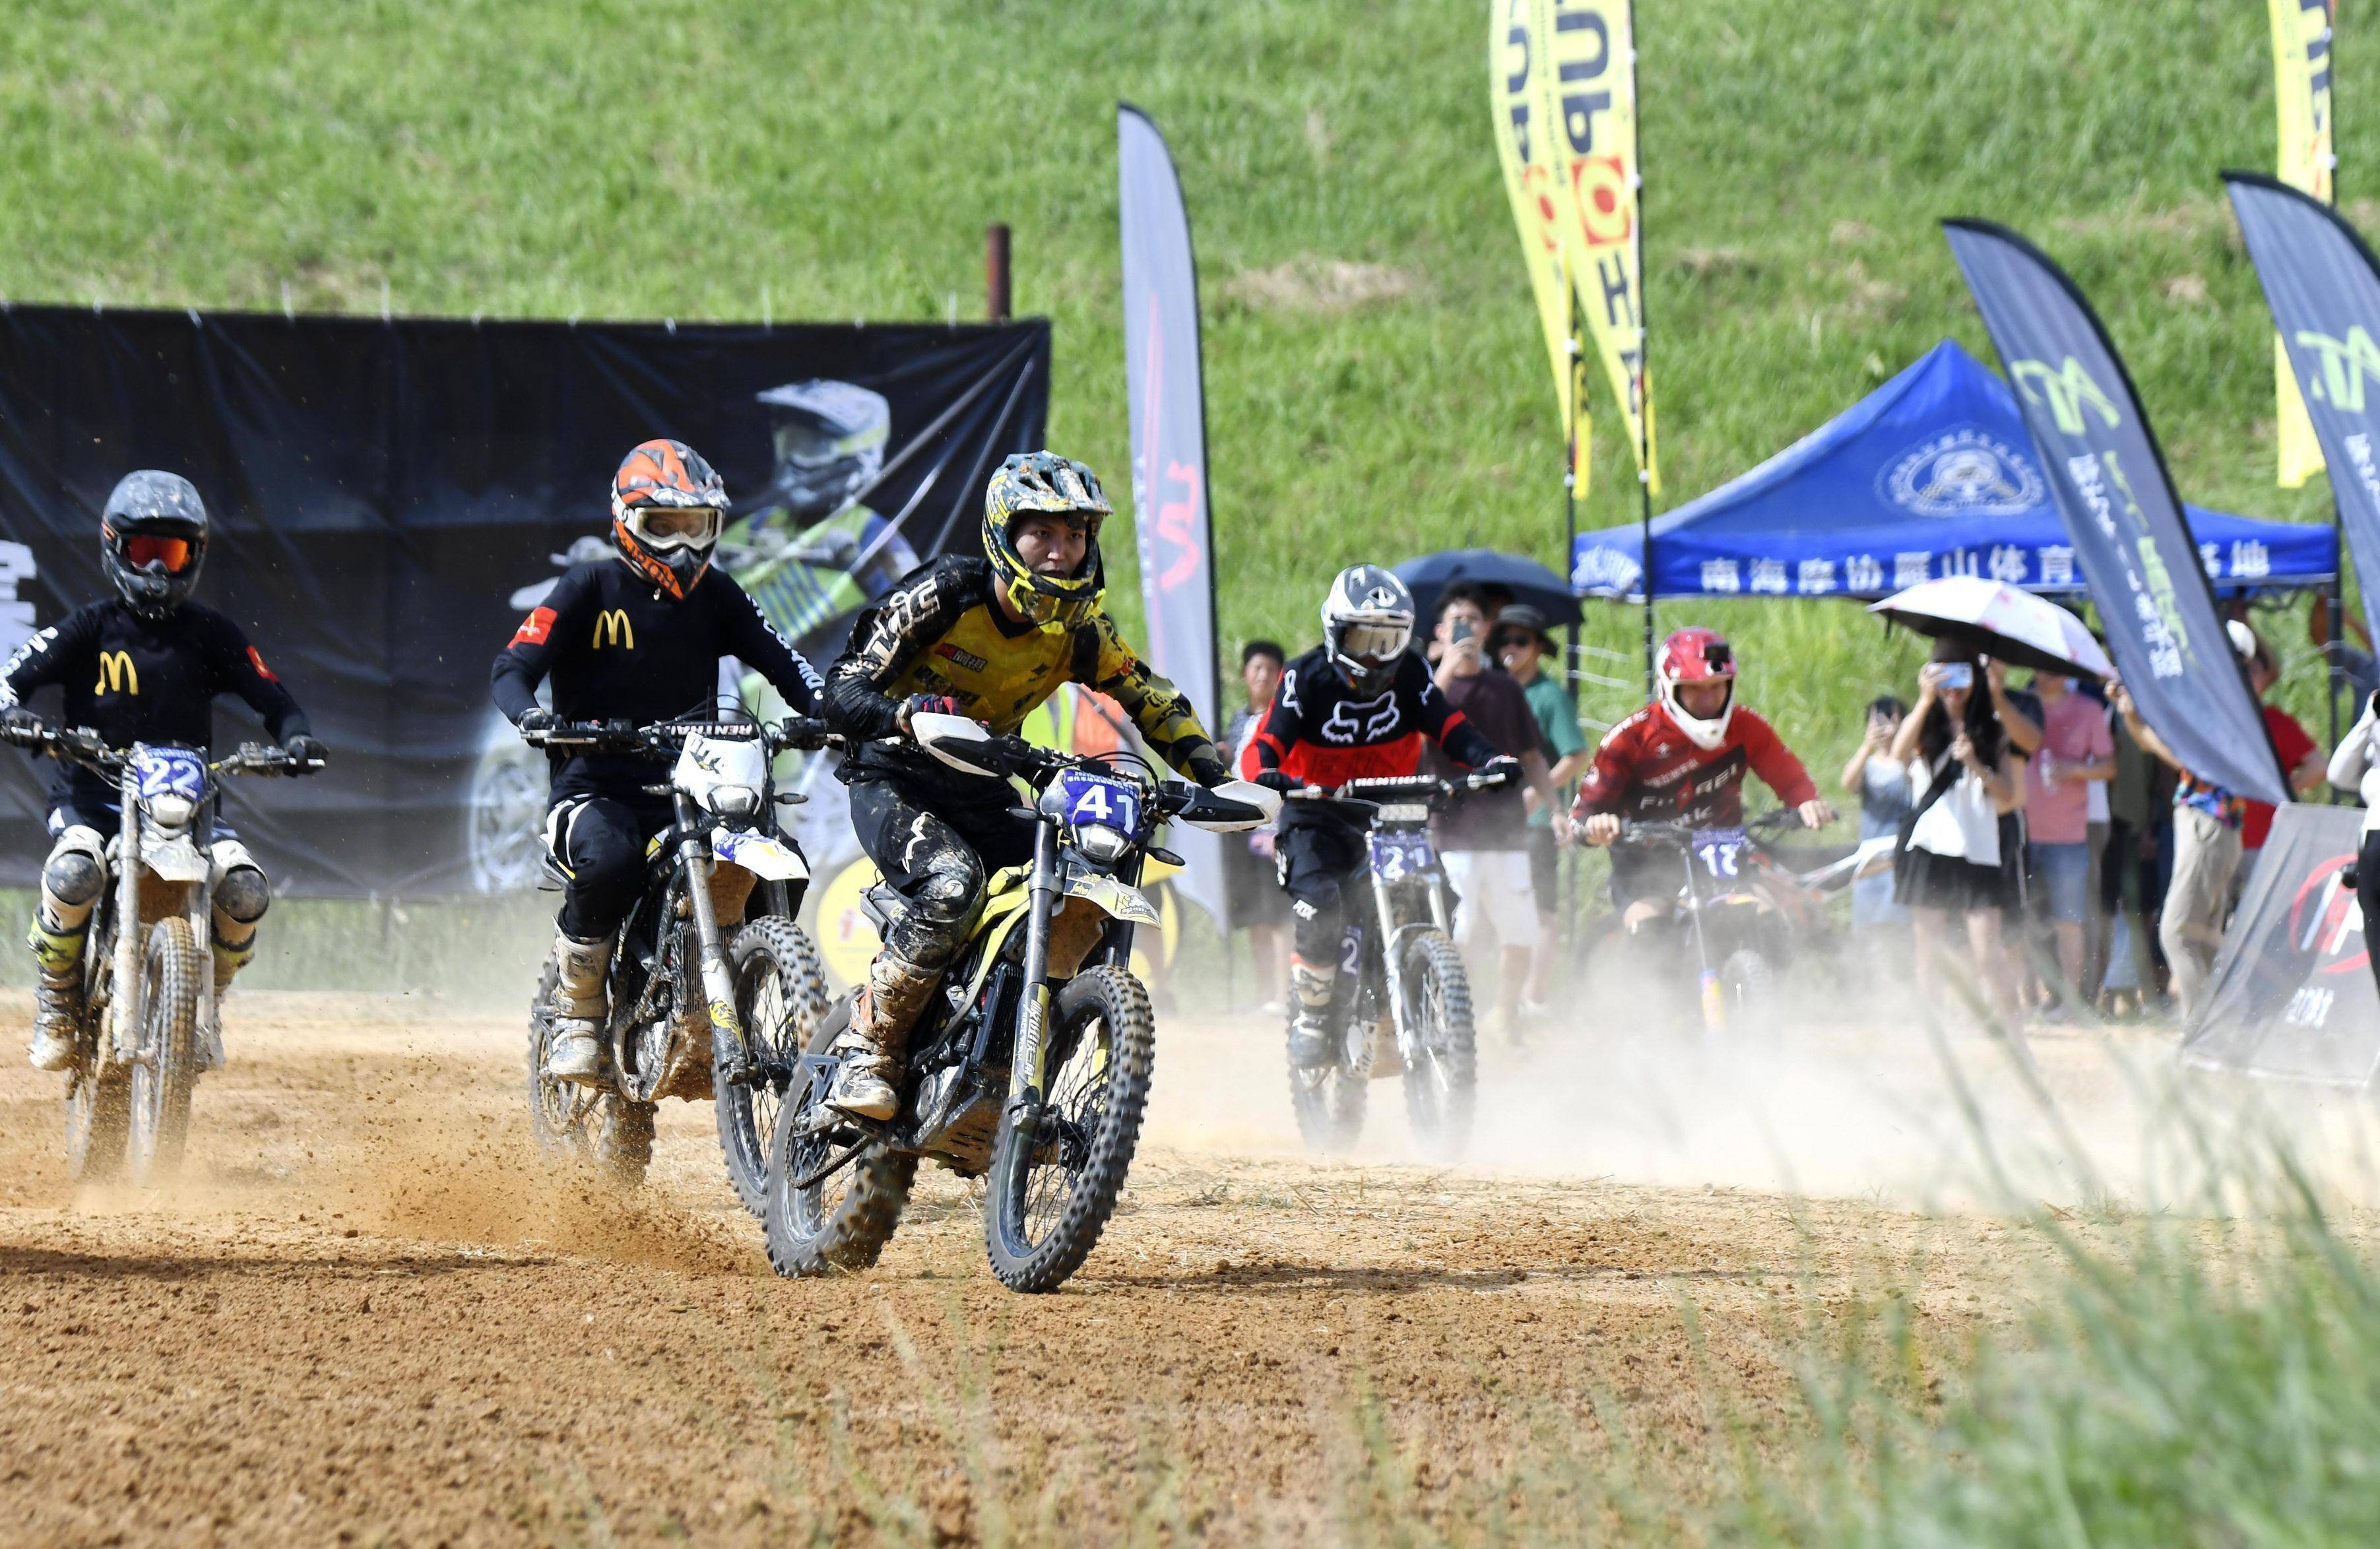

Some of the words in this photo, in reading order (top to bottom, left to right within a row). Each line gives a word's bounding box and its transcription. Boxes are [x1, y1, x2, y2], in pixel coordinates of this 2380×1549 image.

[142, 757, 199, 800] 22
[1076, 784, 1134, 835] 41
[1380, 845, 1426, 879] 21
